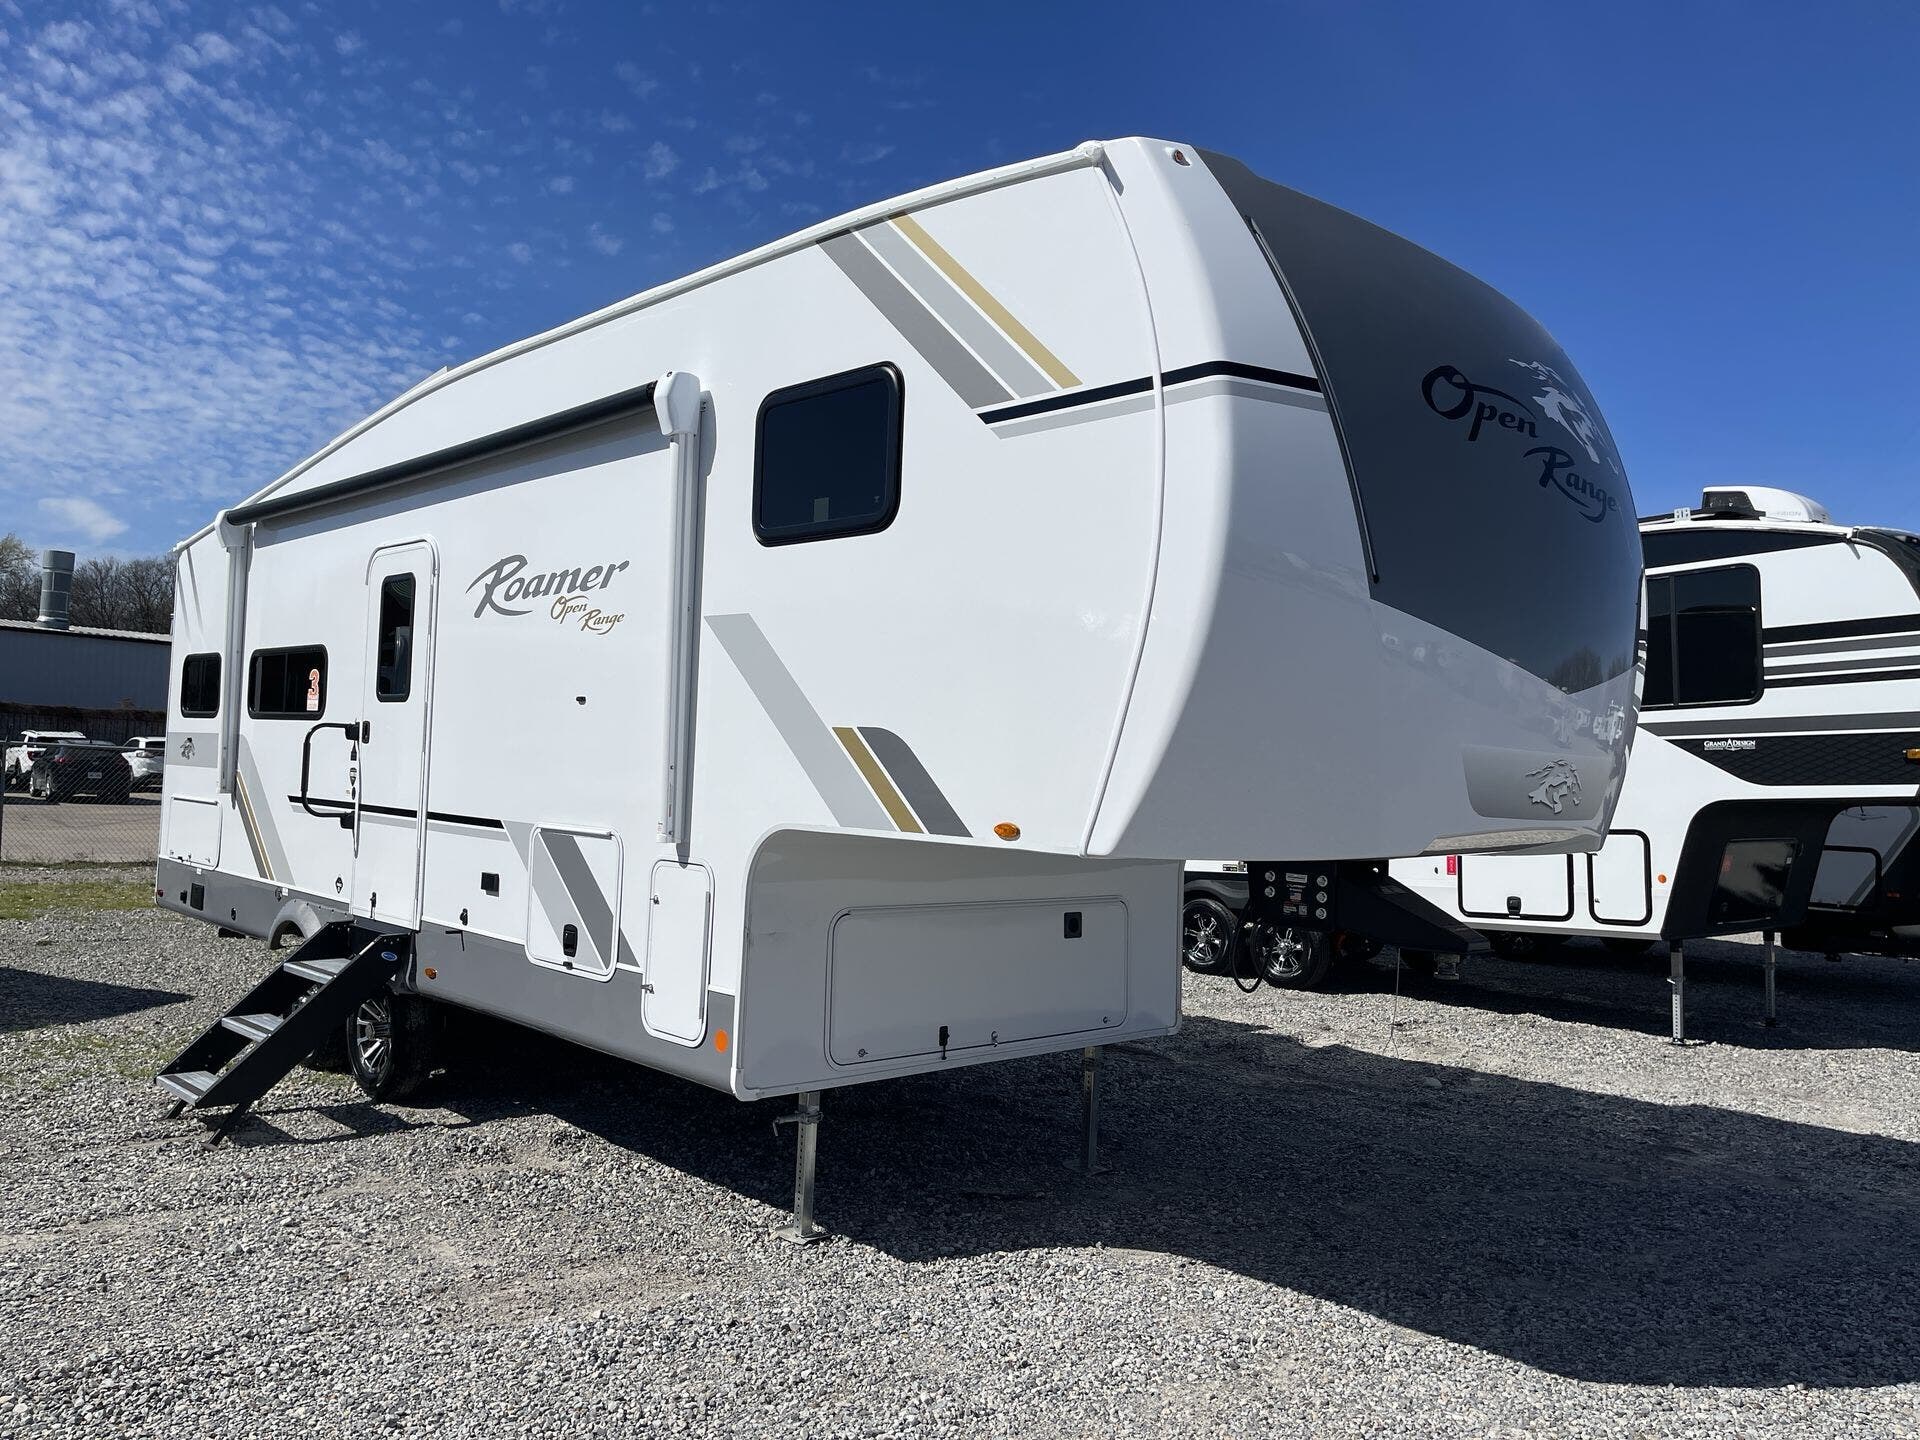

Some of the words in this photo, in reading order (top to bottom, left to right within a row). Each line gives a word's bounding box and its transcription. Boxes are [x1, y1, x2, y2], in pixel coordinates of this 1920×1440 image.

[1421, 365, 1538, 442] Open
[1523, 446, 1618, 523] Range
[465, 554, 630, 618] Roamer
[550, 595, 590, 624] Open
[577, 609, 625, 635] Range
[1703, 740, 1727, 748] GRAND
